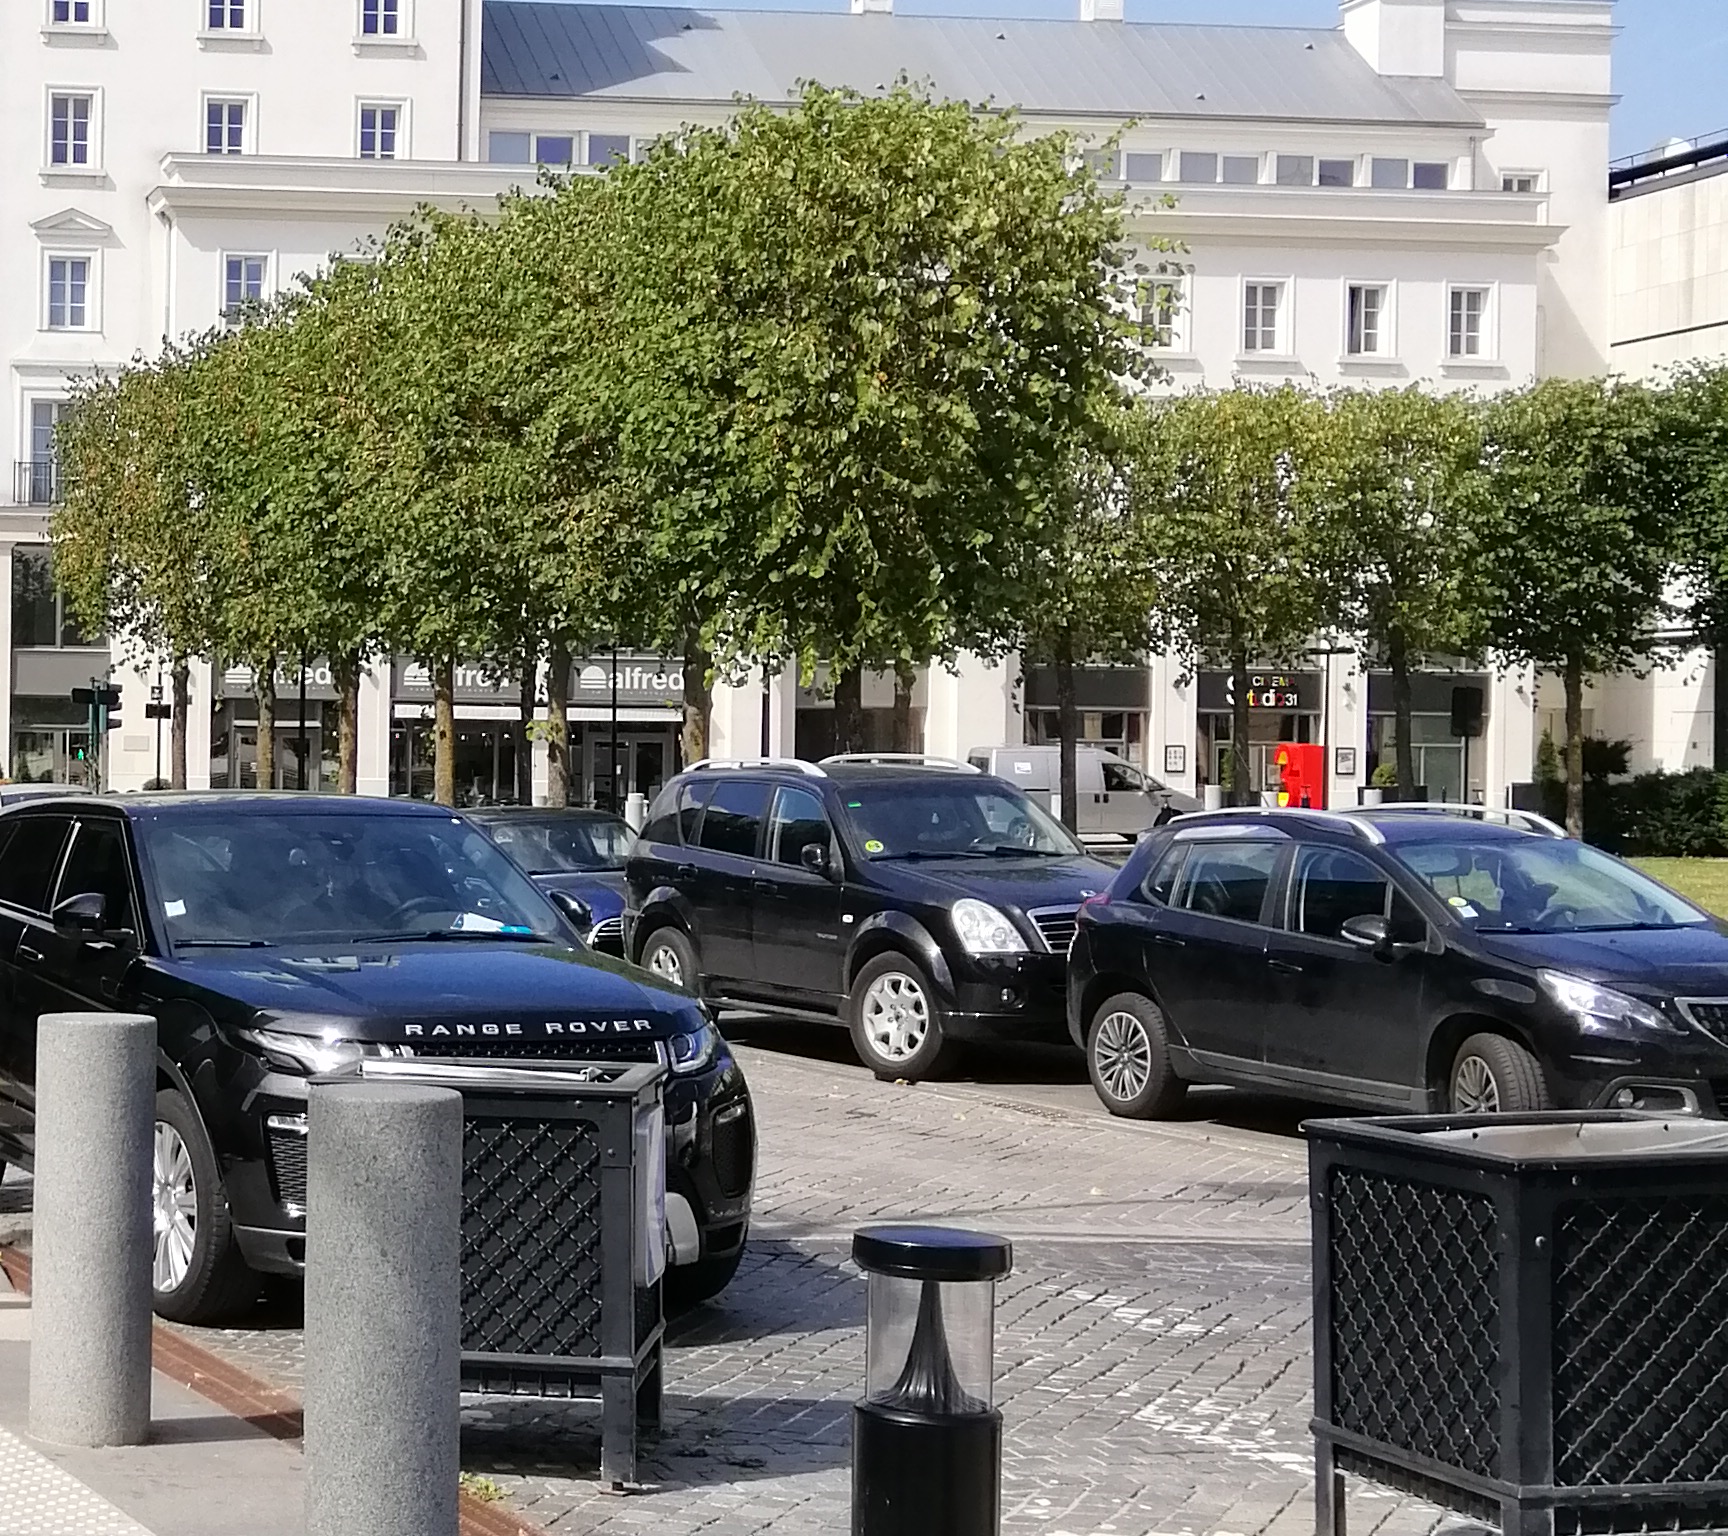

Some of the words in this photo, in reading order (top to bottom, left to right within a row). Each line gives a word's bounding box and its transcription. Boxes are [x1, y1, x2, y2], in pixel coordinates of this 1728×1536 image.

[609, 667, 685, 690] alfred
[405, 1023, 522, 1036] RANGE
[545, 1019, 652, 1035] ROVER
